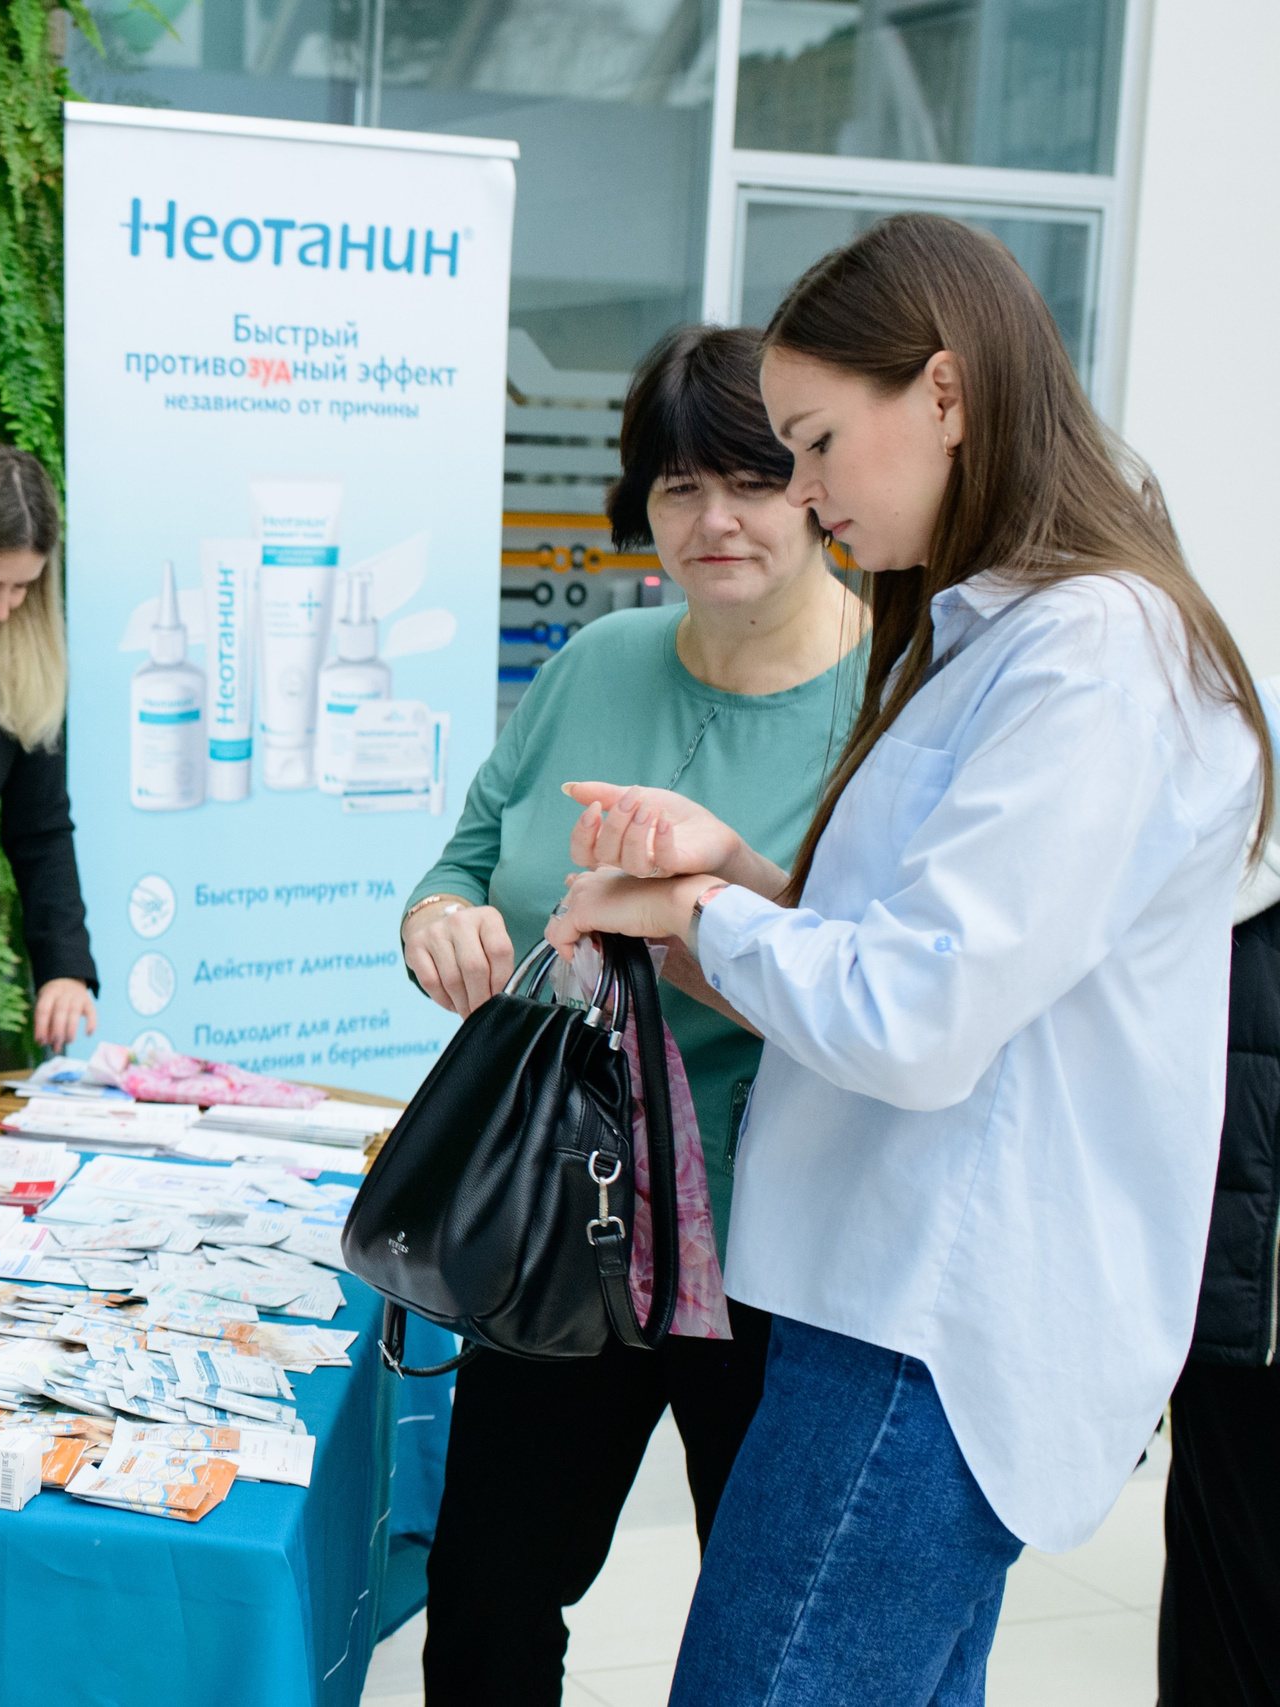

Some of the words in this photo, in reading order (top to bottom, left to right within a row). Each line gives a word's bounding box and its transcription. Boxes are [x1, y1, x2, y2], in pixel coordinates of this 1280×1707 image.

[233, 314, 360, 354] Быстрый
[124, 351, 348, 389] противозудный
[357, 356, 458, 392] эффект
[164, 392, 292, 415] независимо
[299, 400, 322, 415] от
[329, 400, 420, 422] причины
[194, 882, 270, 909] Быстро
[274, 880, 359, 906] купирует
[366, 879, 396, 900] зуд
[193, 956, 295, 984] Действует
[300, 949, 398, 976] длительно
[194, 1018, 291, 1046] Подходит
[297, 1018, 331, 1038] для
[335, 1008, 390, 1034] детей
[311, 1050, 321, 1065] и
[328, 1038, 440, 1067] беременных
